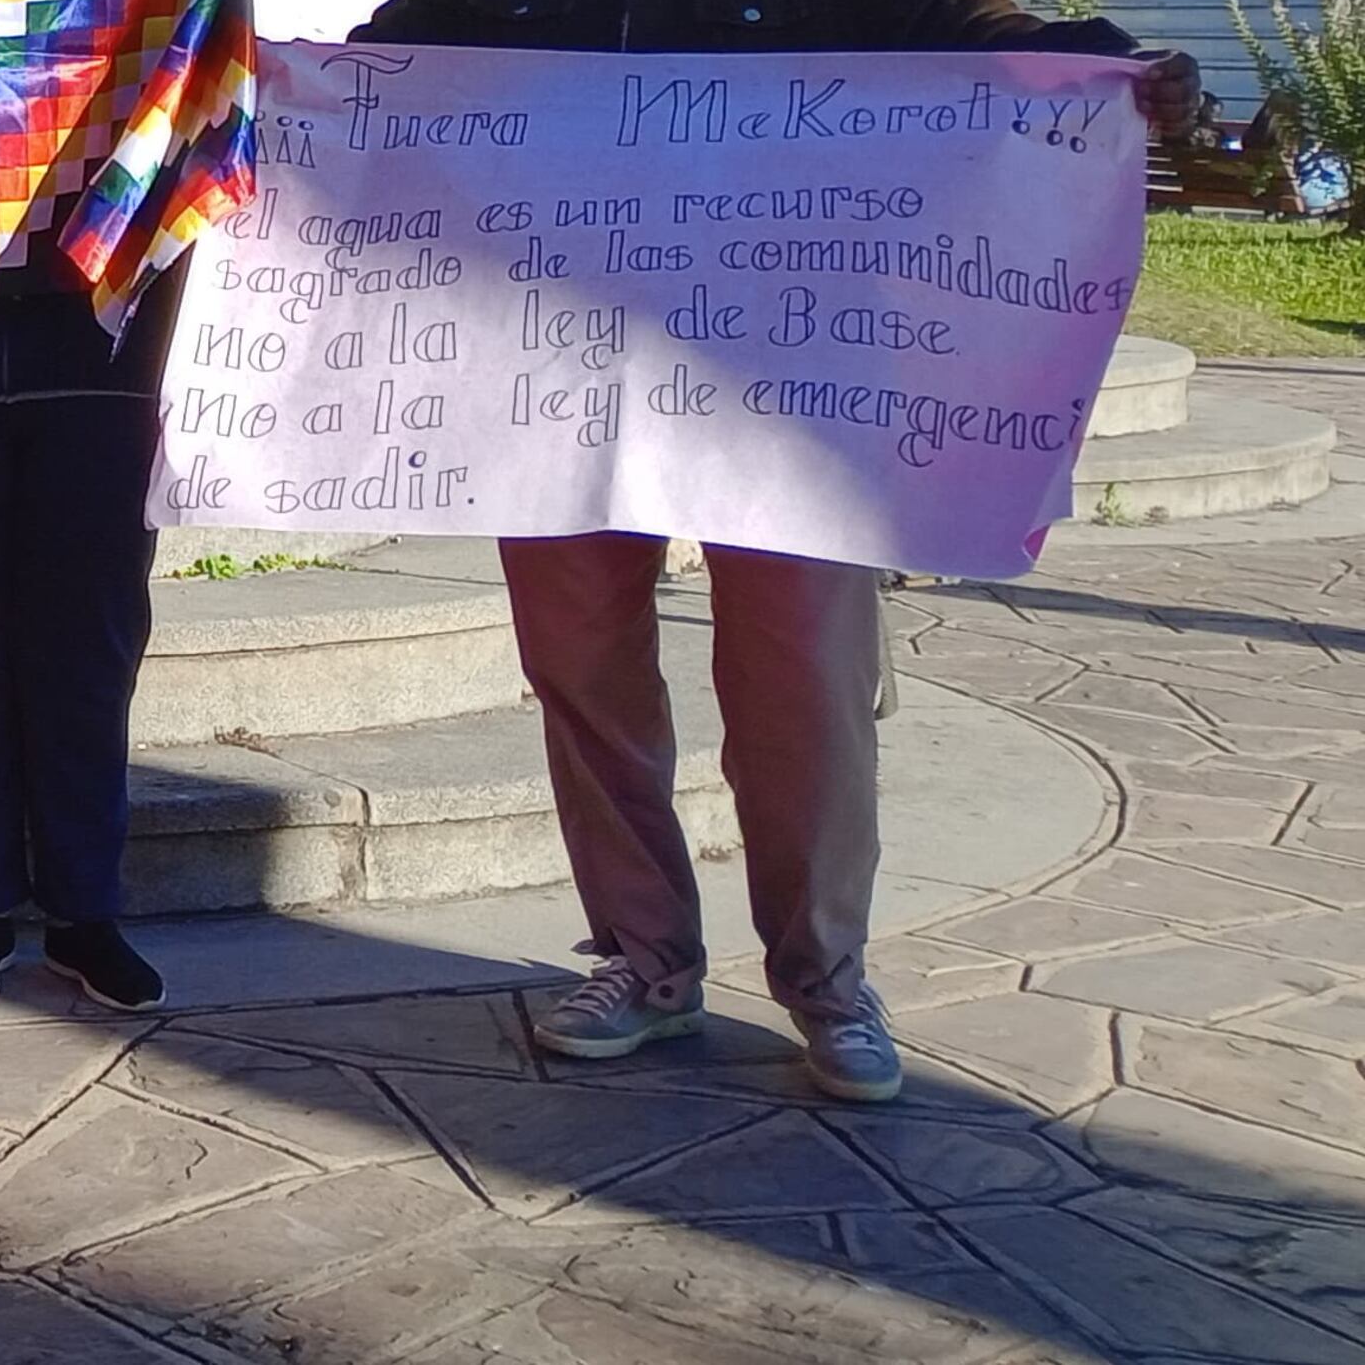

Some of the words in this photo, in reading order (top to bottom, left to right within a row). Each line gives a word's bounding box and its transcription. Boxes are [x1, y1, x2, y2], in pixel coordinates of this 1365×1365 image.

[297, 208, 442, 273] agua
[476, 201, 534, 234] es
[555, 197, 641, 227] un
[673, 186, 924, 225] recurso
[215, 247, 462, 325] sagrado
[509, 235, 570, 283] de
[606, 230, 694, 274] las
[719, 234, 1133, 316] comunidades
[323, 331, 364, 370] a
[388, 302, 458, 365] la
[521, 288, 626, 371] ley
[665, 283, 749, 341] de
[301, 402, 343, 434] a
[373, 379, 445, 435] la
[511, 372, 622, 449] ley
[647, 363, 718, 417] de
[165, 454, 233, 511] de
